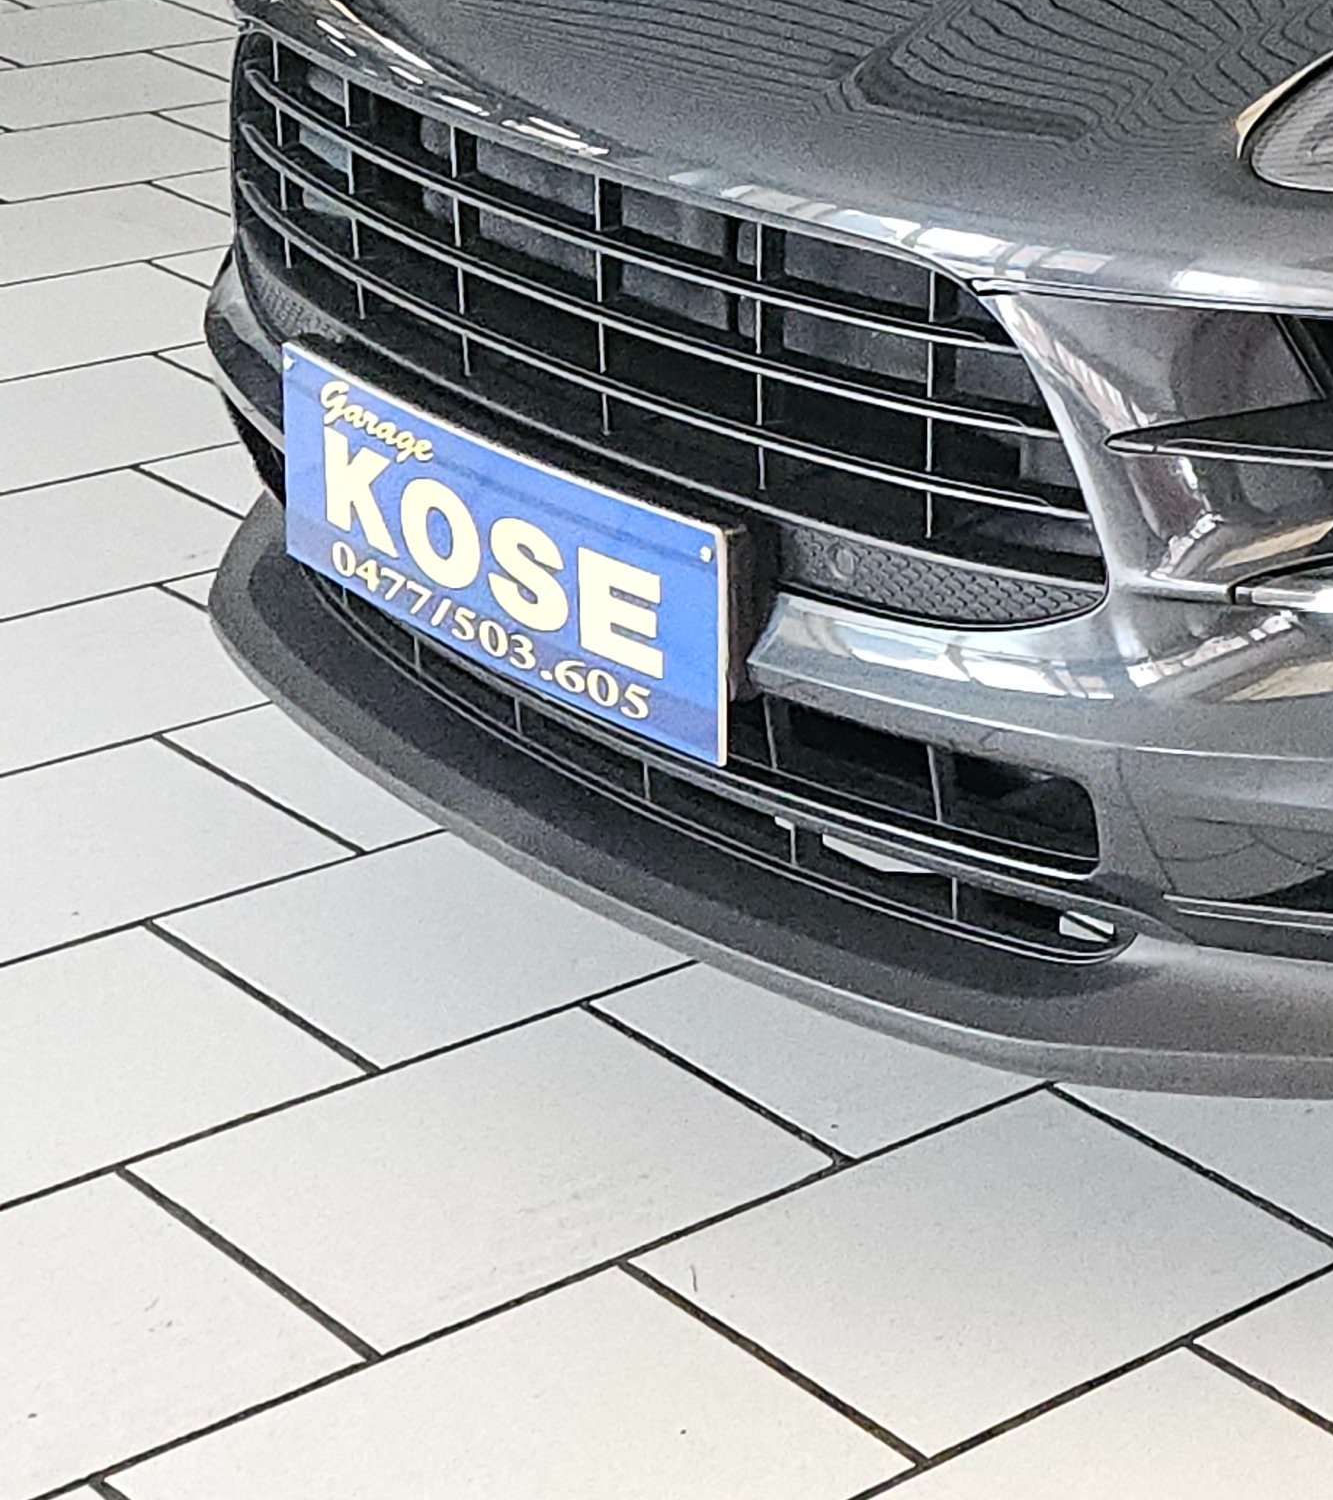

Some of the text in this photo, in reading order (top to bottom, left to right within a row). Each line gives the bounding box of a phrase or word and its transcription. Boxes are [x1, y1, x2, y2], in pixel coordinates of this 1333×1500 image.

[320, 380, 434, 463] Garage
[323, 425, 665, 679] KOSE
[331, 540, 651, 719] 0477/503.605
